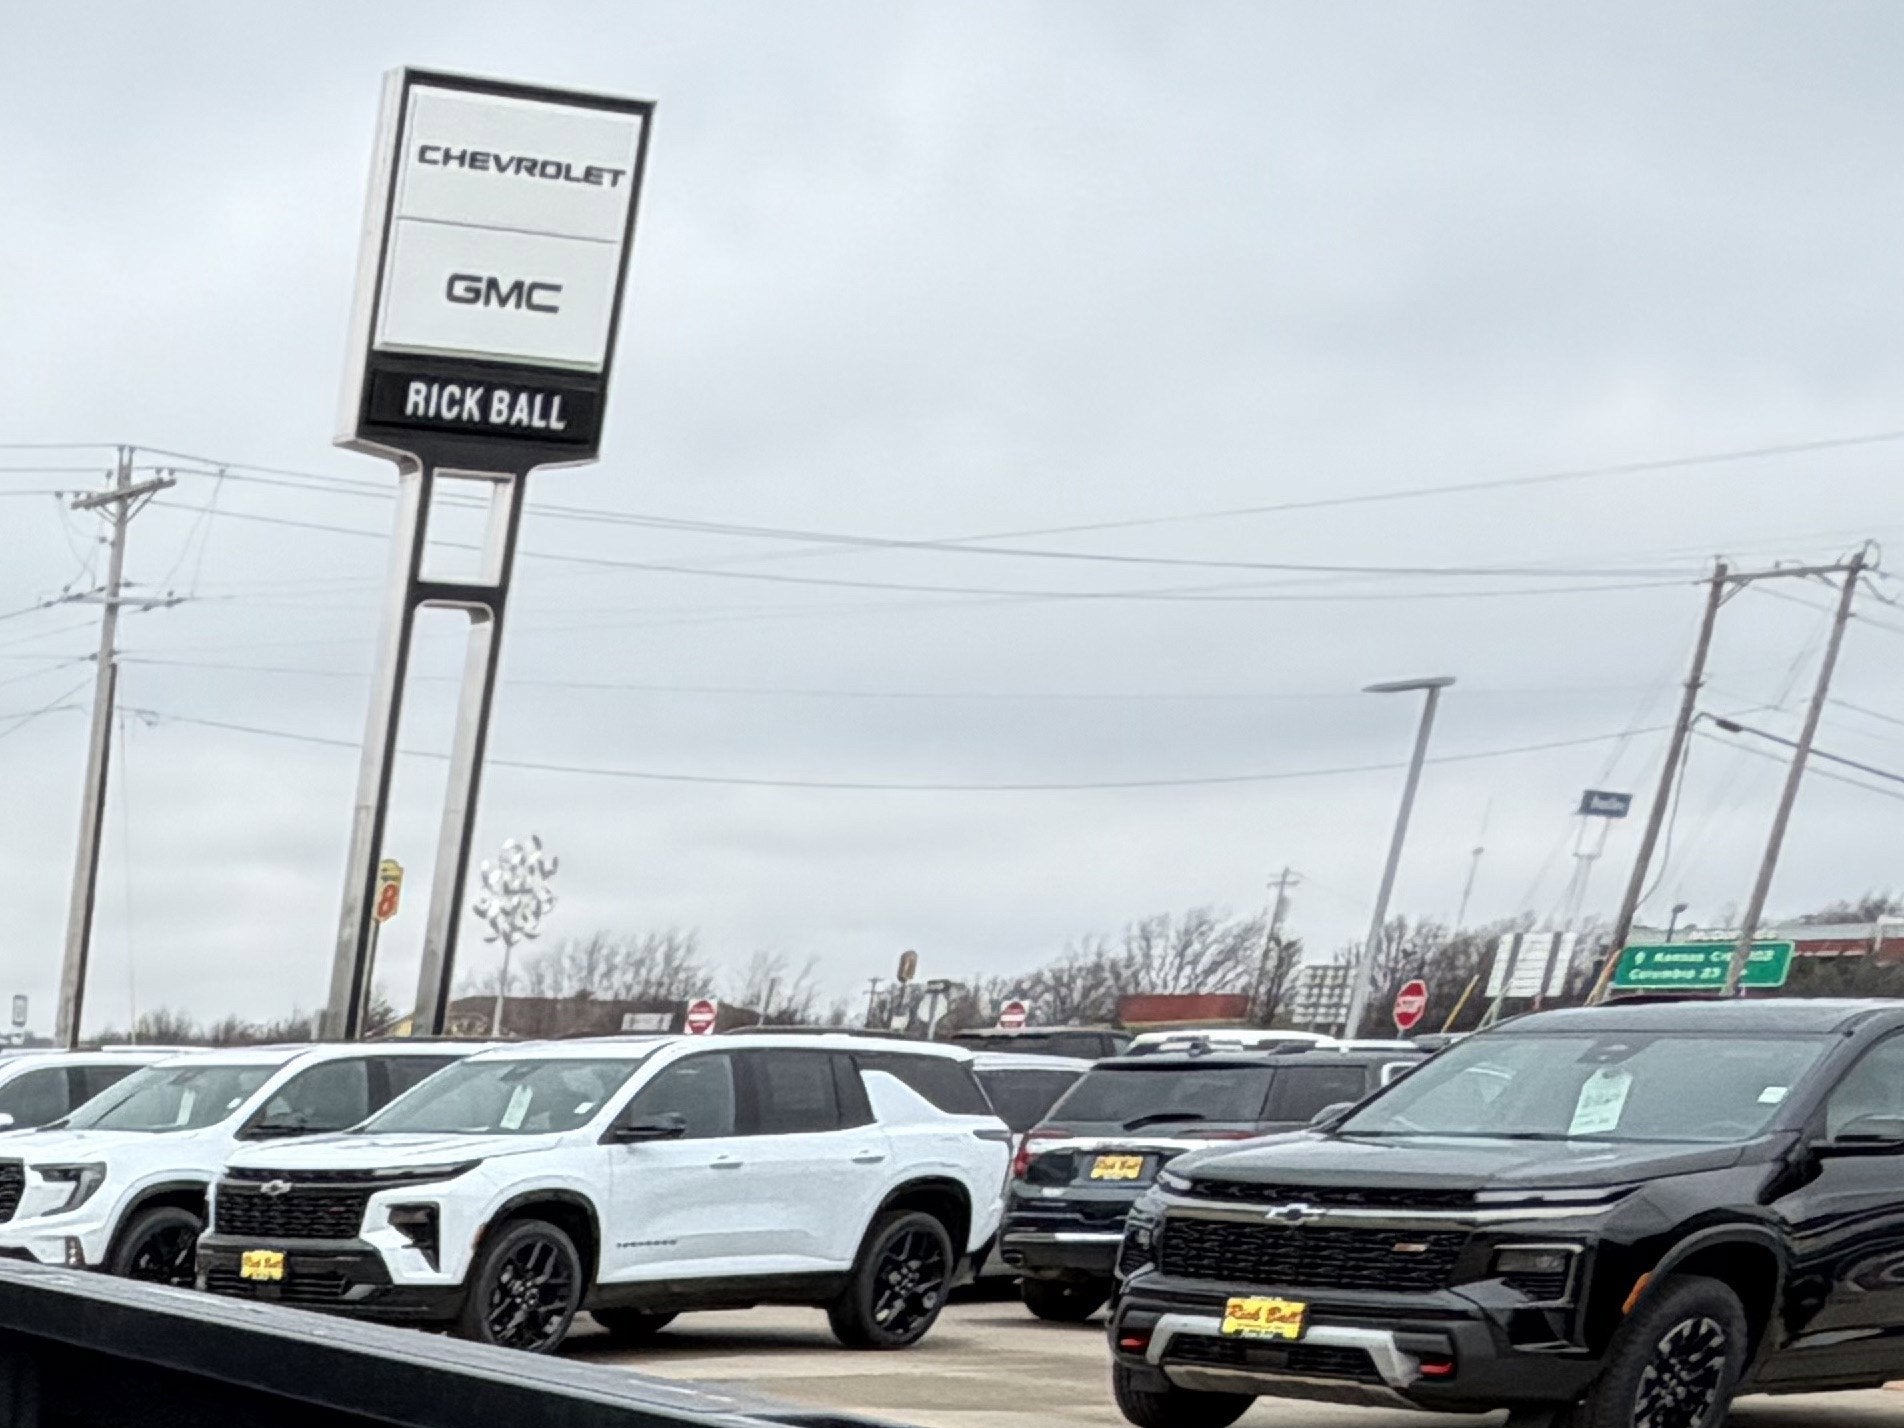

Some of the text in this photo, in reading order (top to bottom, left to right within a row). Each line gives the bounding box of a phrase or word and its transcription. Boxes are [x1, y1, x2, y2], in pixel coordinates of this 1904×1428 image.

[417, 143, 626, 188] CHEVROLET
[445, 272, 563, 314] GMC
[404, 380, 568, 431] RICK BALL
